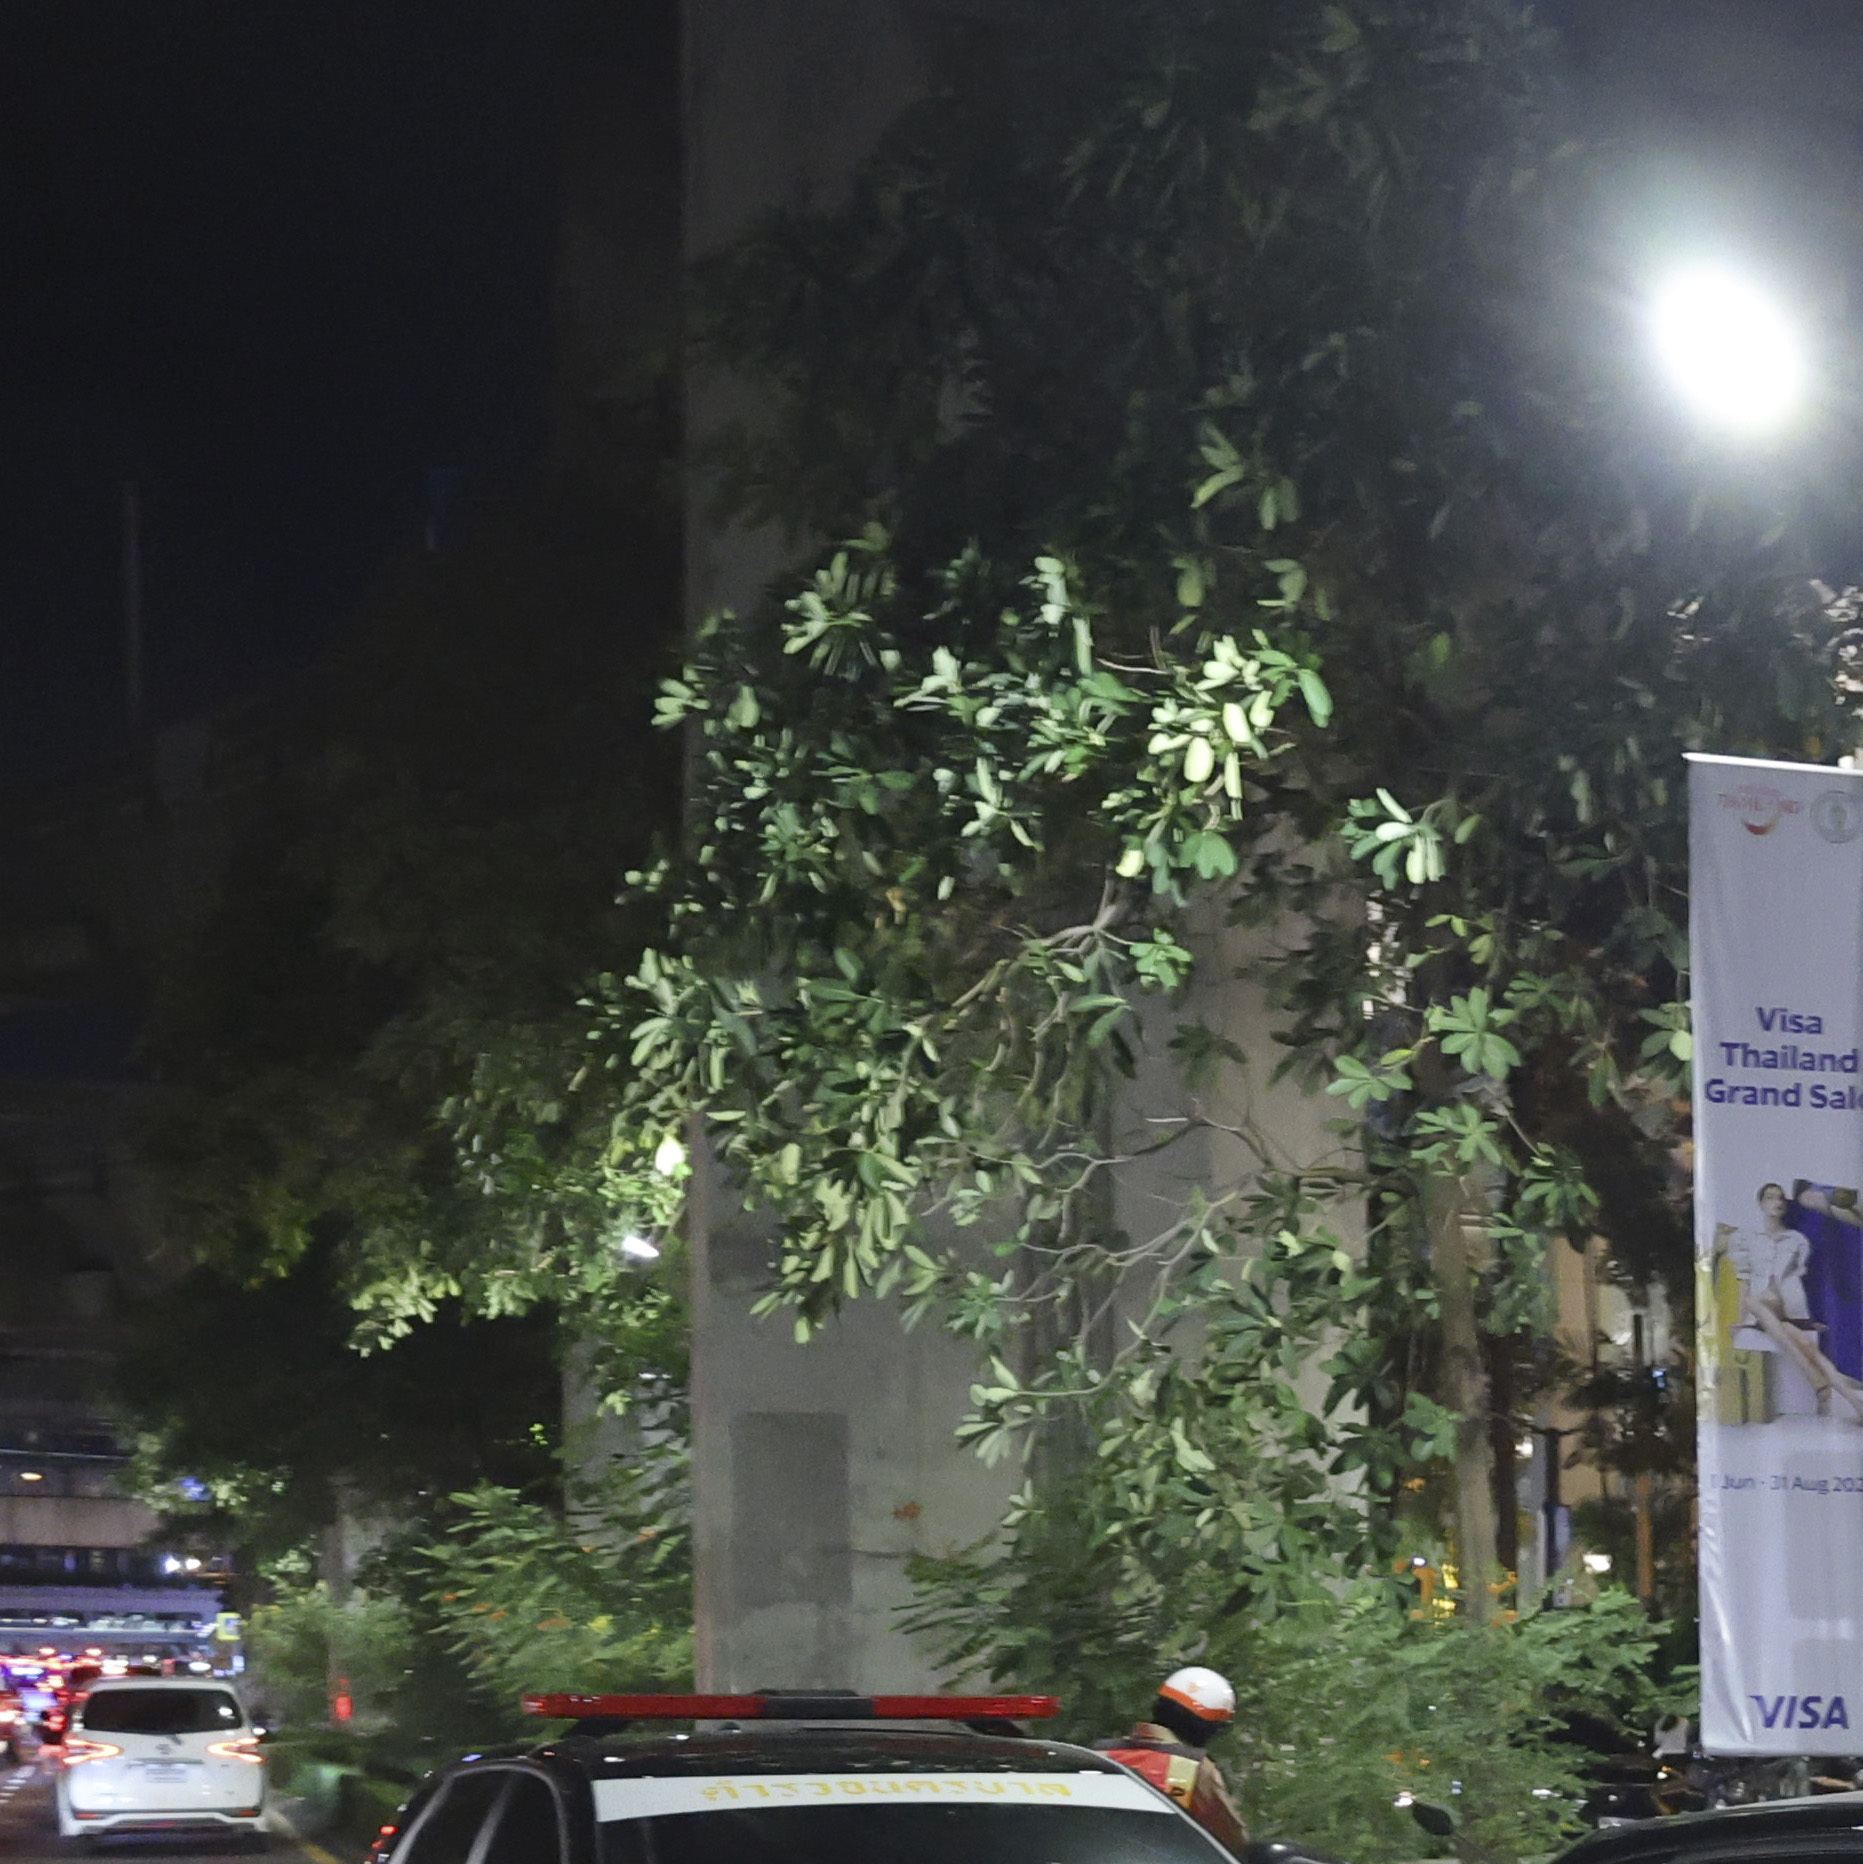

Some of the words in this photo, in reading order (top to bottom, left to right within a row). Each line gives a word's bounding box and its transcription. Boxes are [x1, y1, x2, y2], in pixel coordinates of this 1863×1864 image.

[1756, 1006, 1824, 1035] Visa
[1719, 1041, 1859, 1074] Thailand
[1704, 1078, 1802, 1108] Grand
[1791, 1476, 1829, 1495] Aug
[1749, 1694, 1850, 1730] VISA
